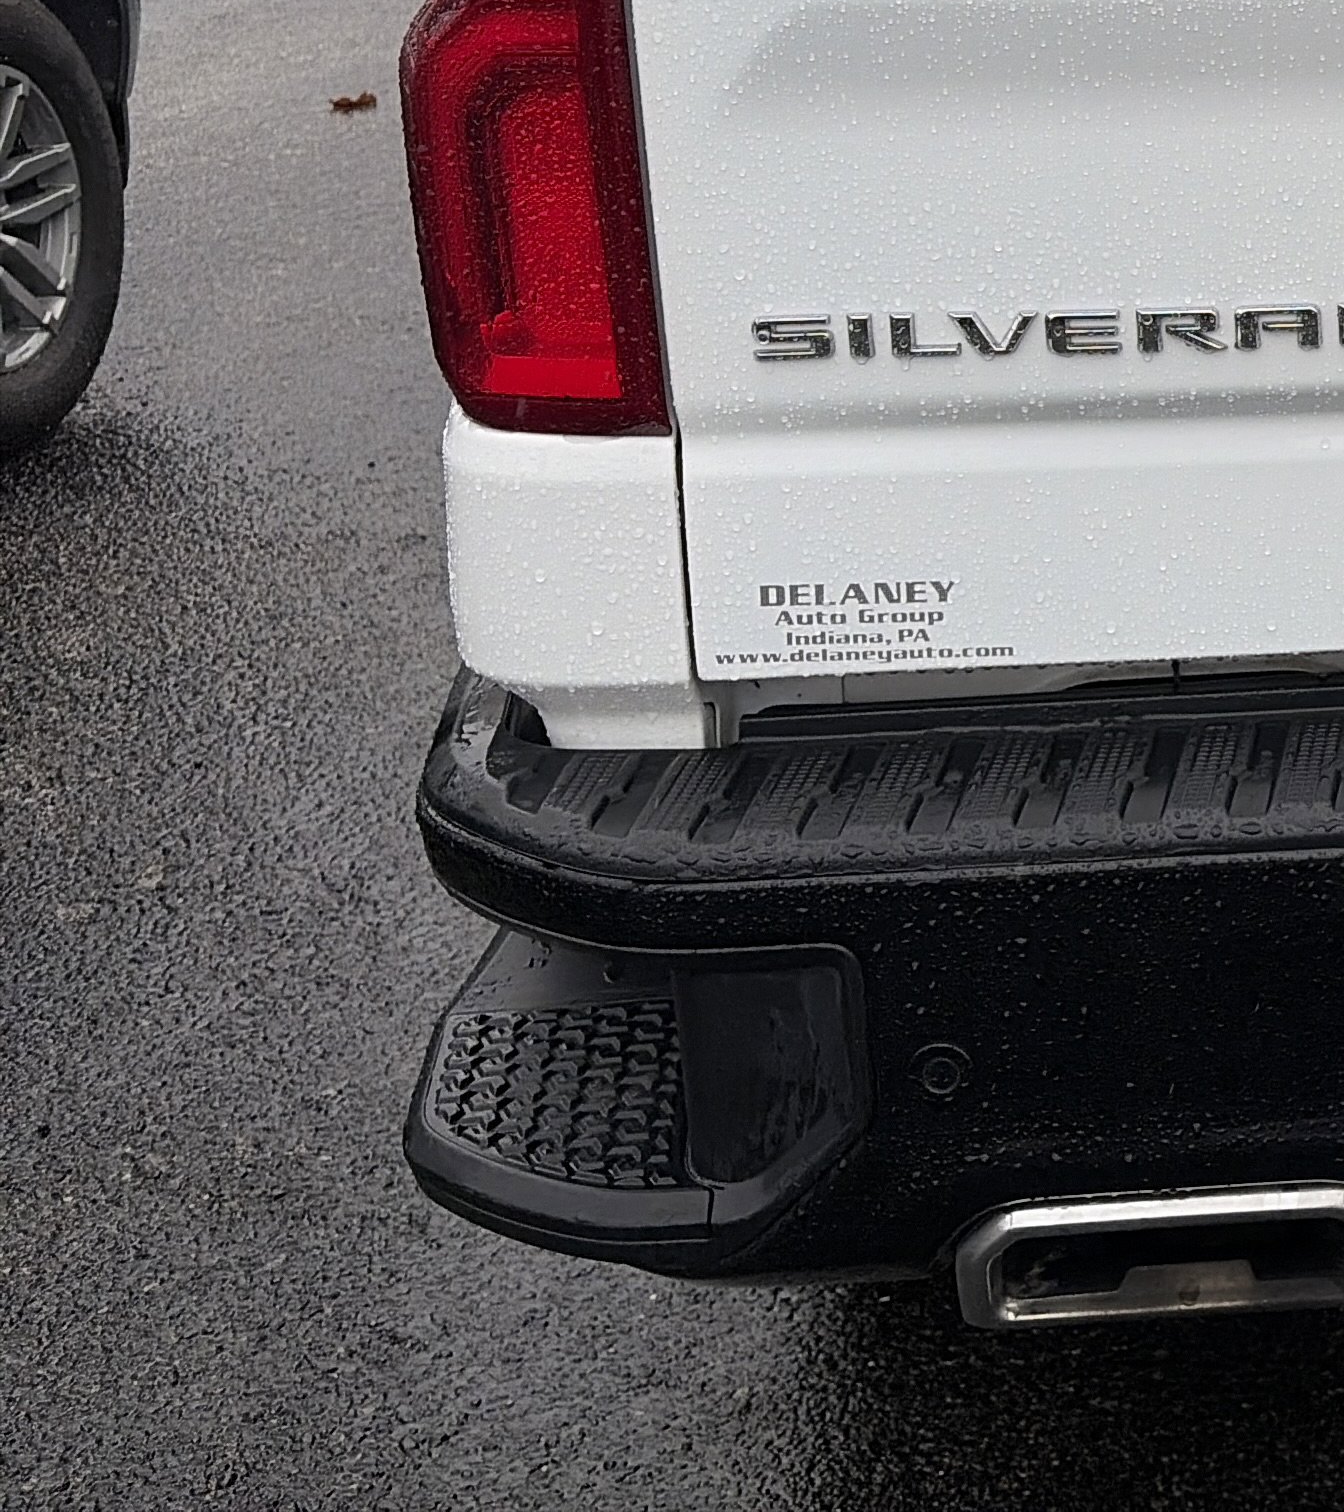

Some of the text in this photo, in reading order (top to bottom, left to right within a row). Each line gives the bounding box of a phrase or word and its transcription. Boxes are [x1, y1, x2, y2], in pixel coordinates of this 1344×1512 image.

[759, 581, 955, 606] DELANEY
[775, 609, 944, 626] Auto Group
[786, 628, 930, 646] Indiana, PA
[715, 645, 1014, 664] www.delaneyauto.com
